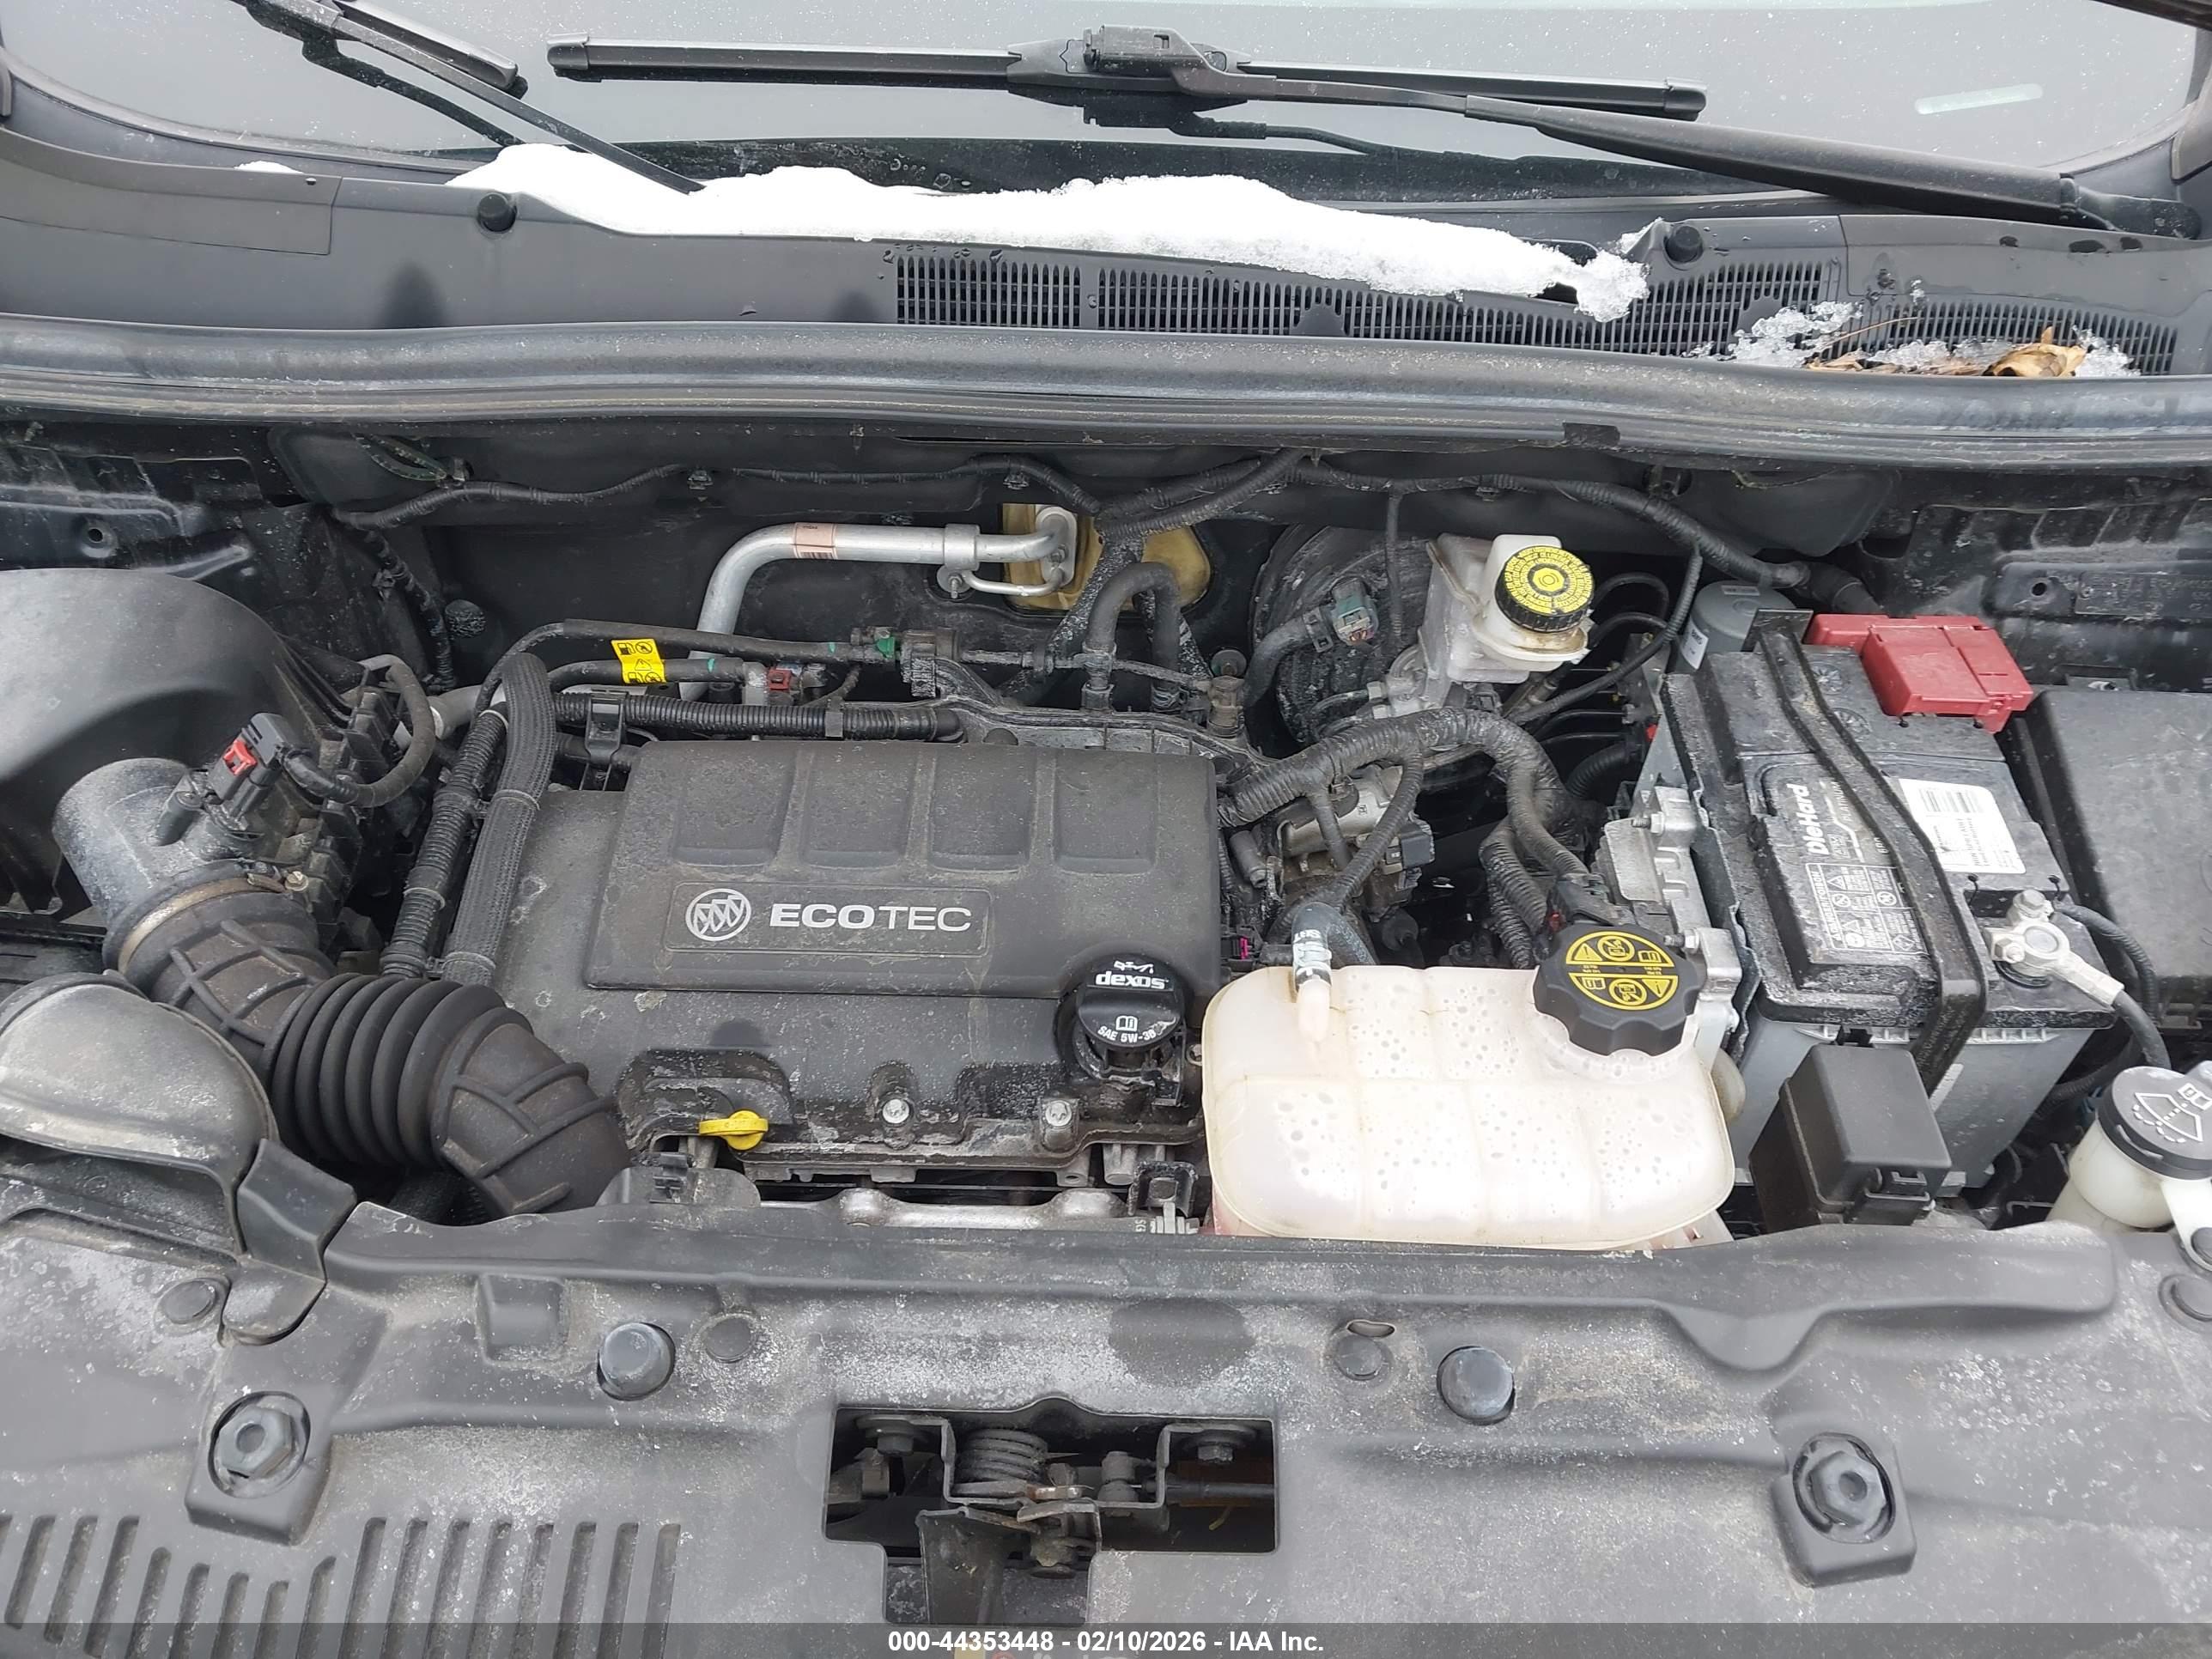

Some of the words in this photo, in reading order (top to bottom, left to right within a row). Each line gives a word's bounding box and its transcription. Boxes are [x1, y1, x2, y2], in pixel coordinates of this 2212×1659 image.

[769, 902, 972, 932] ECOTEC
[1095, 971, 1166, 990] dexos
[1097, 1025, 1118, 1042] SAE
